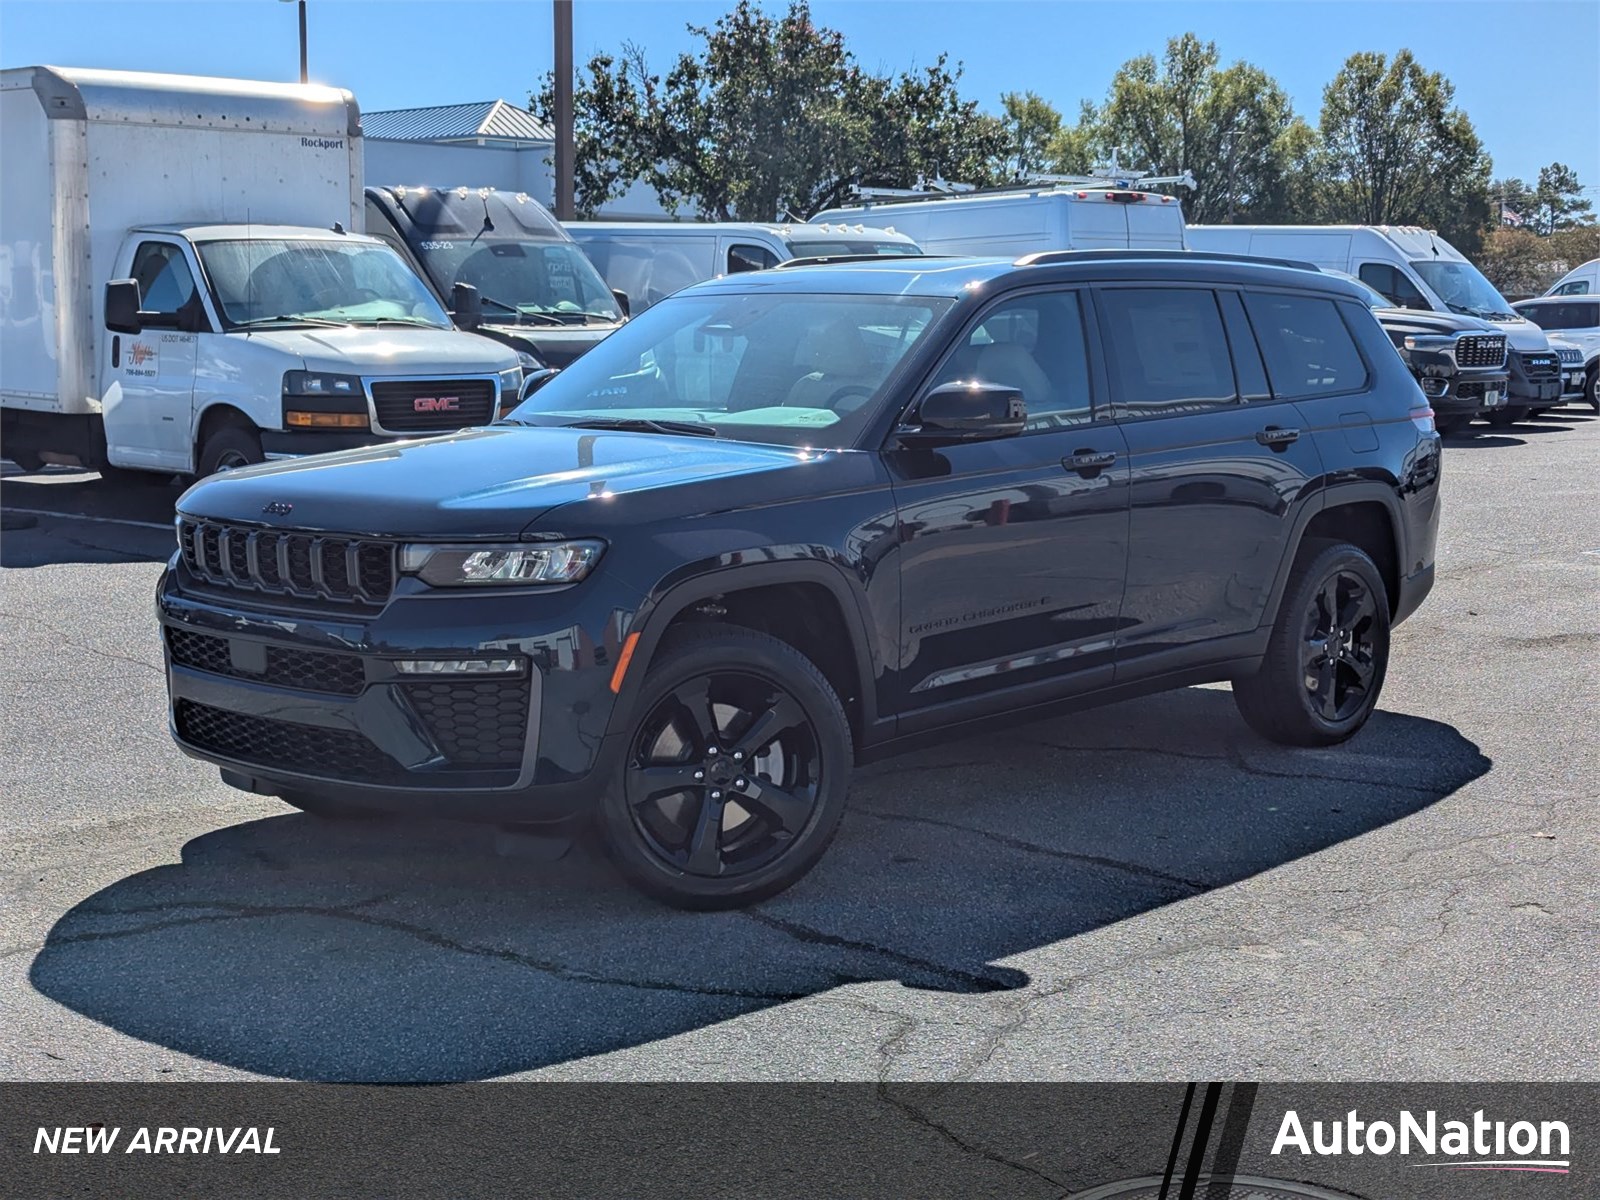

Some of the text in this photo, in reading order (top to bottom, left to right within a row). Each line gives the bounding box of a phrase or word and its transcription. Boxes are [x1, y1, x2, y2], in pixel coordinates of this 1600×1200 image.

[301, 137, 343, 150] Rockport
[421, 241, 454, 250] 535-23
[1477, 340, 1502, 349] RAM
[414, 397, 459, 411] GMC
[262, 501, 292, 516] Jeep
[909, 617, 959, 634] GRAND
